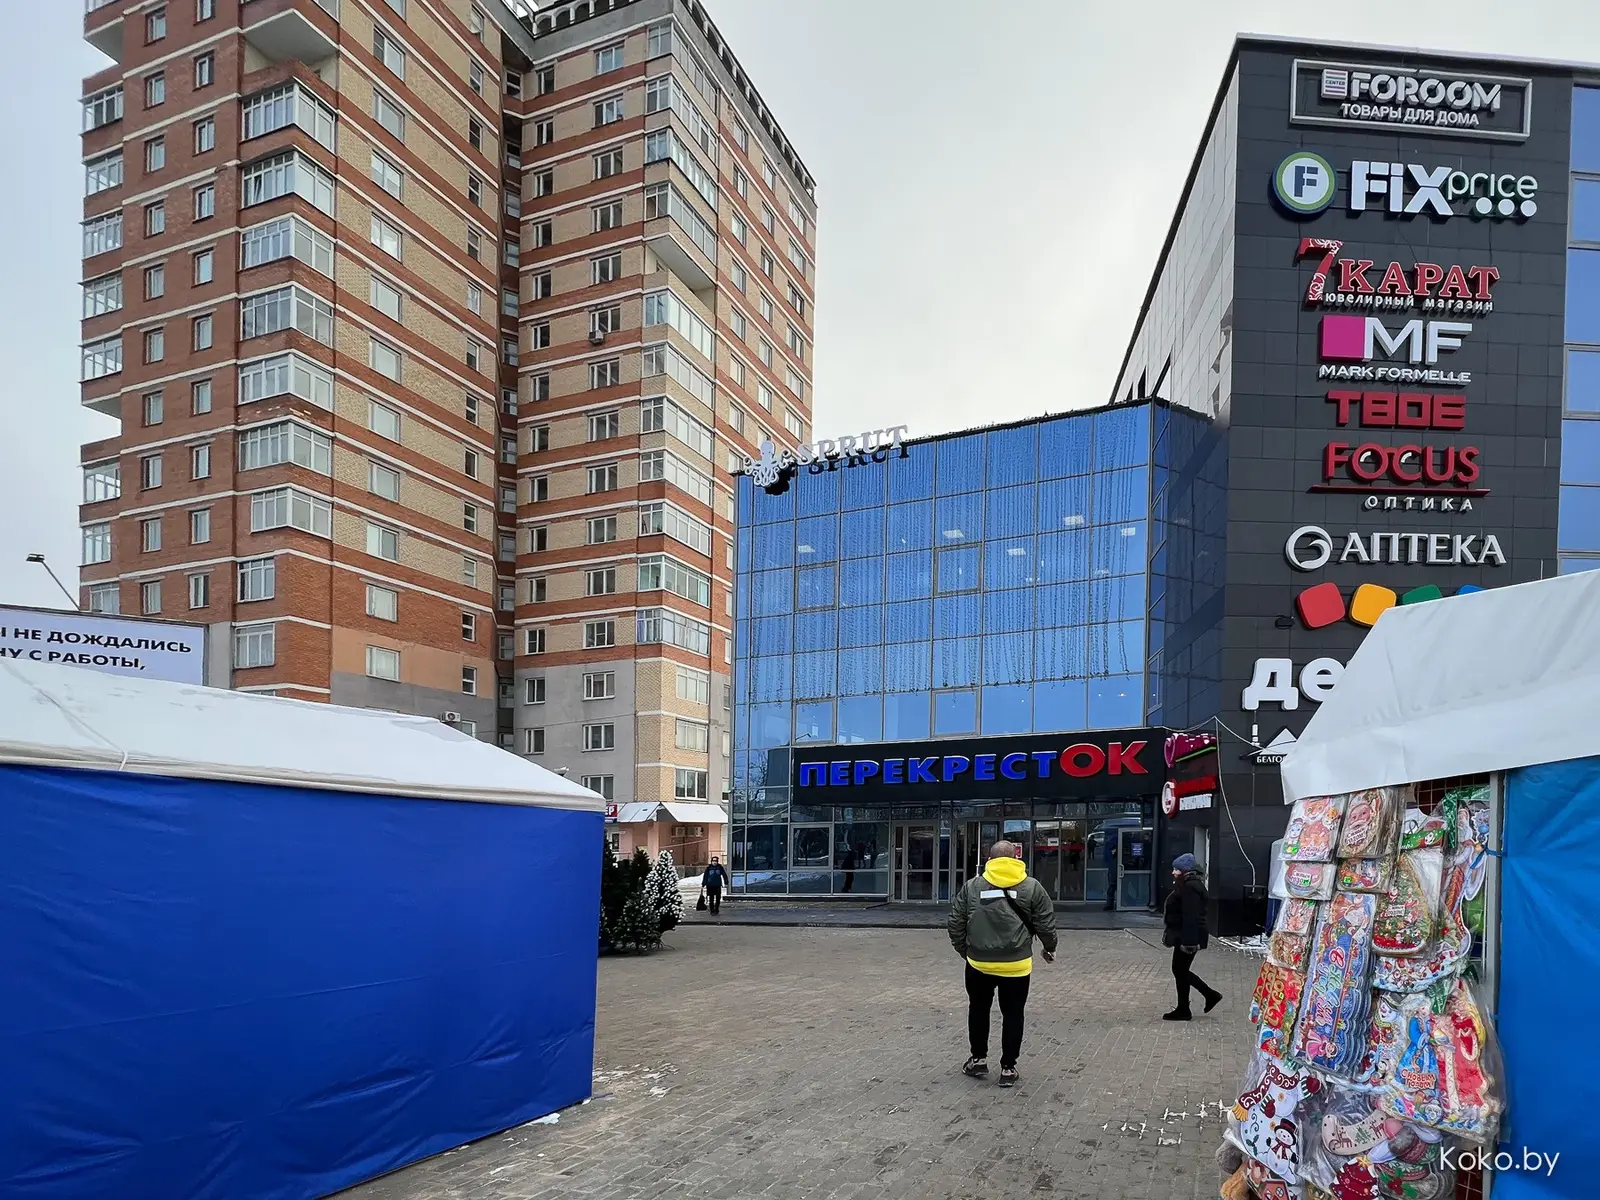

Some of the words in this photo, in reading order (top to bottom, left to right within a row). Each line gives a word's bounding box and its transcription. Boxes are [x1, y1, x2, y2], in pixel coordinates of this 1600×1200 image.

[1351, 71, 1501, 111] FOROOM
[1341, 103, 1402, 119] ТОВАРЫ
[1404, 107, 1435, 123] ДЛЯ
[1435, 111, 1480, 126] ДОМА
[1298, 237, 1343, 303] 7
[1337, 258, 1500, 300] КАРАТ
[1325, 292, 1415, 307] ювелирный
[1425, 300, 1494, 312] магазин
[1363, 316, 1473, 365] MF
[1320, 364, 1375, 379] MARK
[1376, 367, 1472, 384] FORMELLE
[796, 424, 909, 466] SPRUT
[1323, 442, 1480, 484] FOCUS
[1365, 495, 1474, 511] ОПТИКА
[1340, 532, 1507, 565] АПТЕКА
[14, 627, 42, 641] НЕ
[46, 630, 192, 654] ДОЖДАЛИСЬ
[28, 649, 42, 661] С
[48, 651, 146, 671] РАБОТЫ,
[800, 740, 1149, 788] ПЕРЕКРЕСТОК
